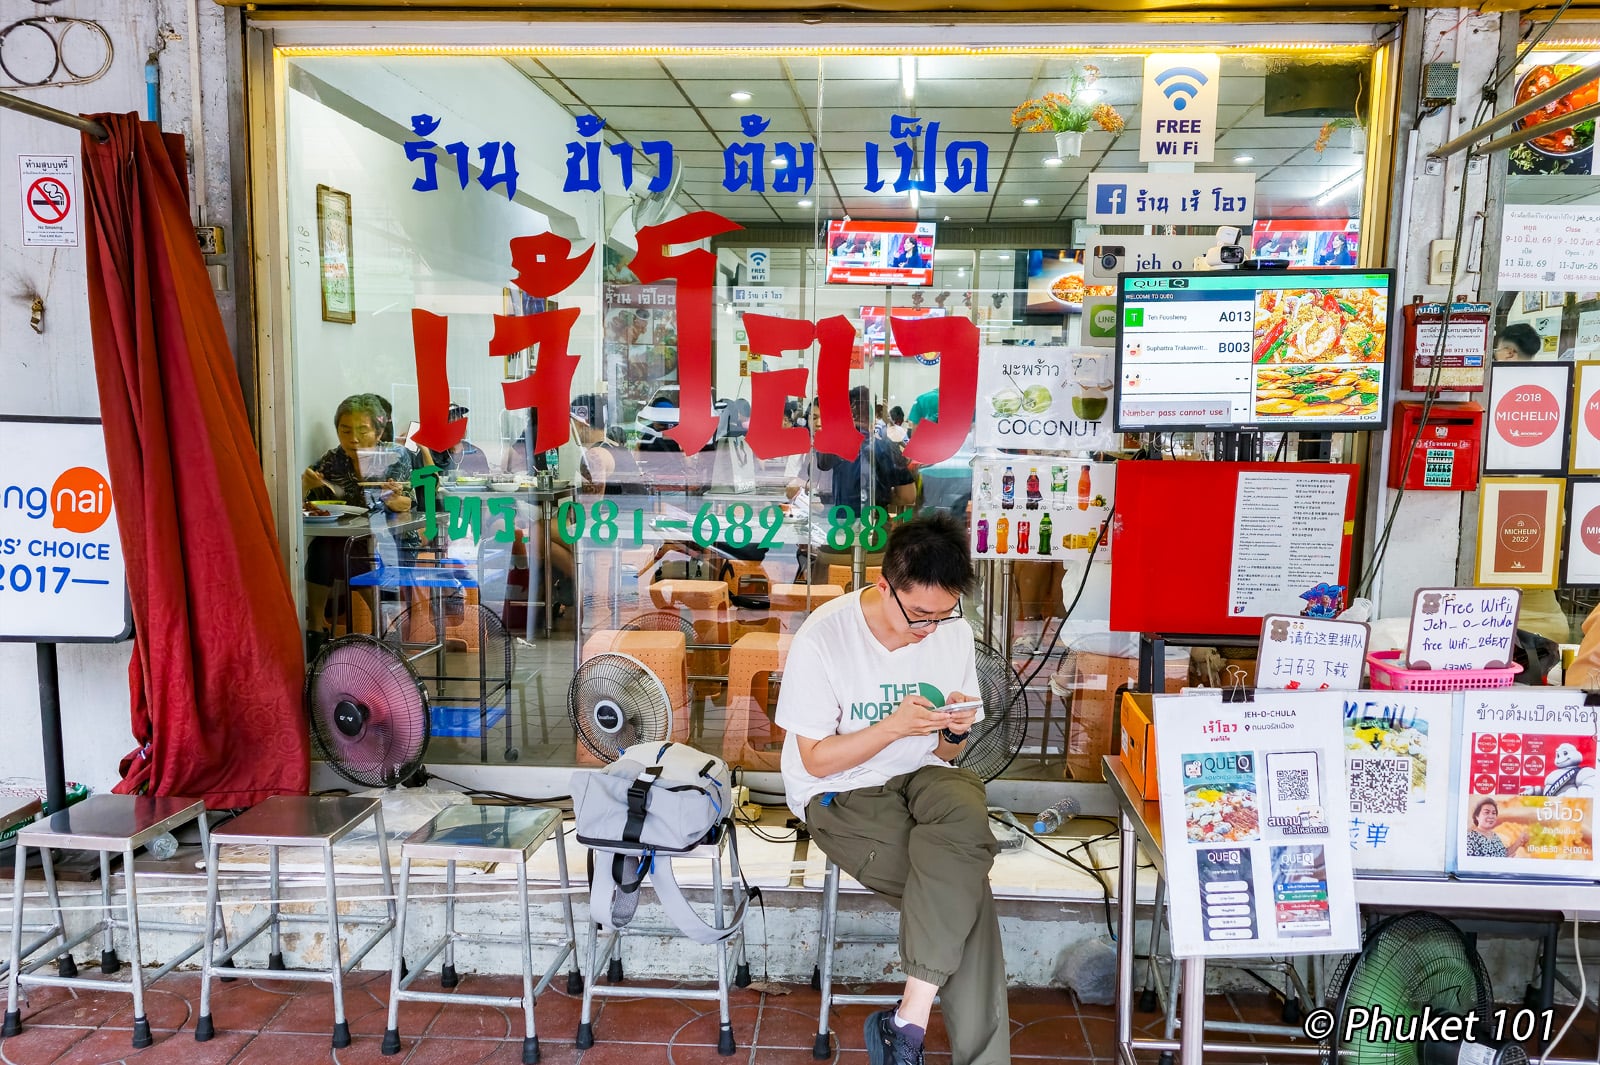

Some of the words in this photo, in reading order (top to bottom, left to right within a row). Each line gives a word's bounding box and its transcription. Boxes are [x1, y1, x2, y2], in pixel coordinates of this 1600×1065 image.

[1156, 119, 1201, 133] FREE
[404, 114, 519, 201] ร้าน
[563, 114, 673, 192] ข้าว
[722, 114, 814, 195] ต้ม
[864, 114, 989, 193] เป็ด
[1136, 189, 1169, 214] ร้าน
[1211, 187, 1247, 212] โอว
[605, 285, 632, 304] ร้าน
[1131, 313, 1138, 322] T
[1219, 311, 1252, 322] A013
[1218, 342, 1250, 353] B003
[1002, 359, 1060, 376] มะพร้าว
[1515, 393, 1542, 402] 2018
[1122, 409, 1155, 417] Number
[1158, 410, 1177, 418] pass
[1180, 408, 1206, 417] cannot
[1496, 411, 1559, 421] MICHELIN
[997, 418, 1102, 437] COCONUT
[411, 465, 529, 546] โทร.
[557, 499, 784, 549] 081-682
[28, 540, 110, 560] CHOICE
[1444, 600, 1474, 615] Free
[1289, 630, 1363, 648] 请在这里排队
[1422, 638, 1443, 651] free
[1272, 656, 1316, 677] 扫码
[1323, 659, 1350, 678] 下载
[880, 683, 918, 702] THE
[850, 702, 902, 720] NOR
[1244, 710, 1297, 719] JEH-O-CHULA
[1343, 700, 1419, 731] MENU
[1268, 815, 1302, 827] สแกน
[1207, 852, 1240, 864] QUEQ
